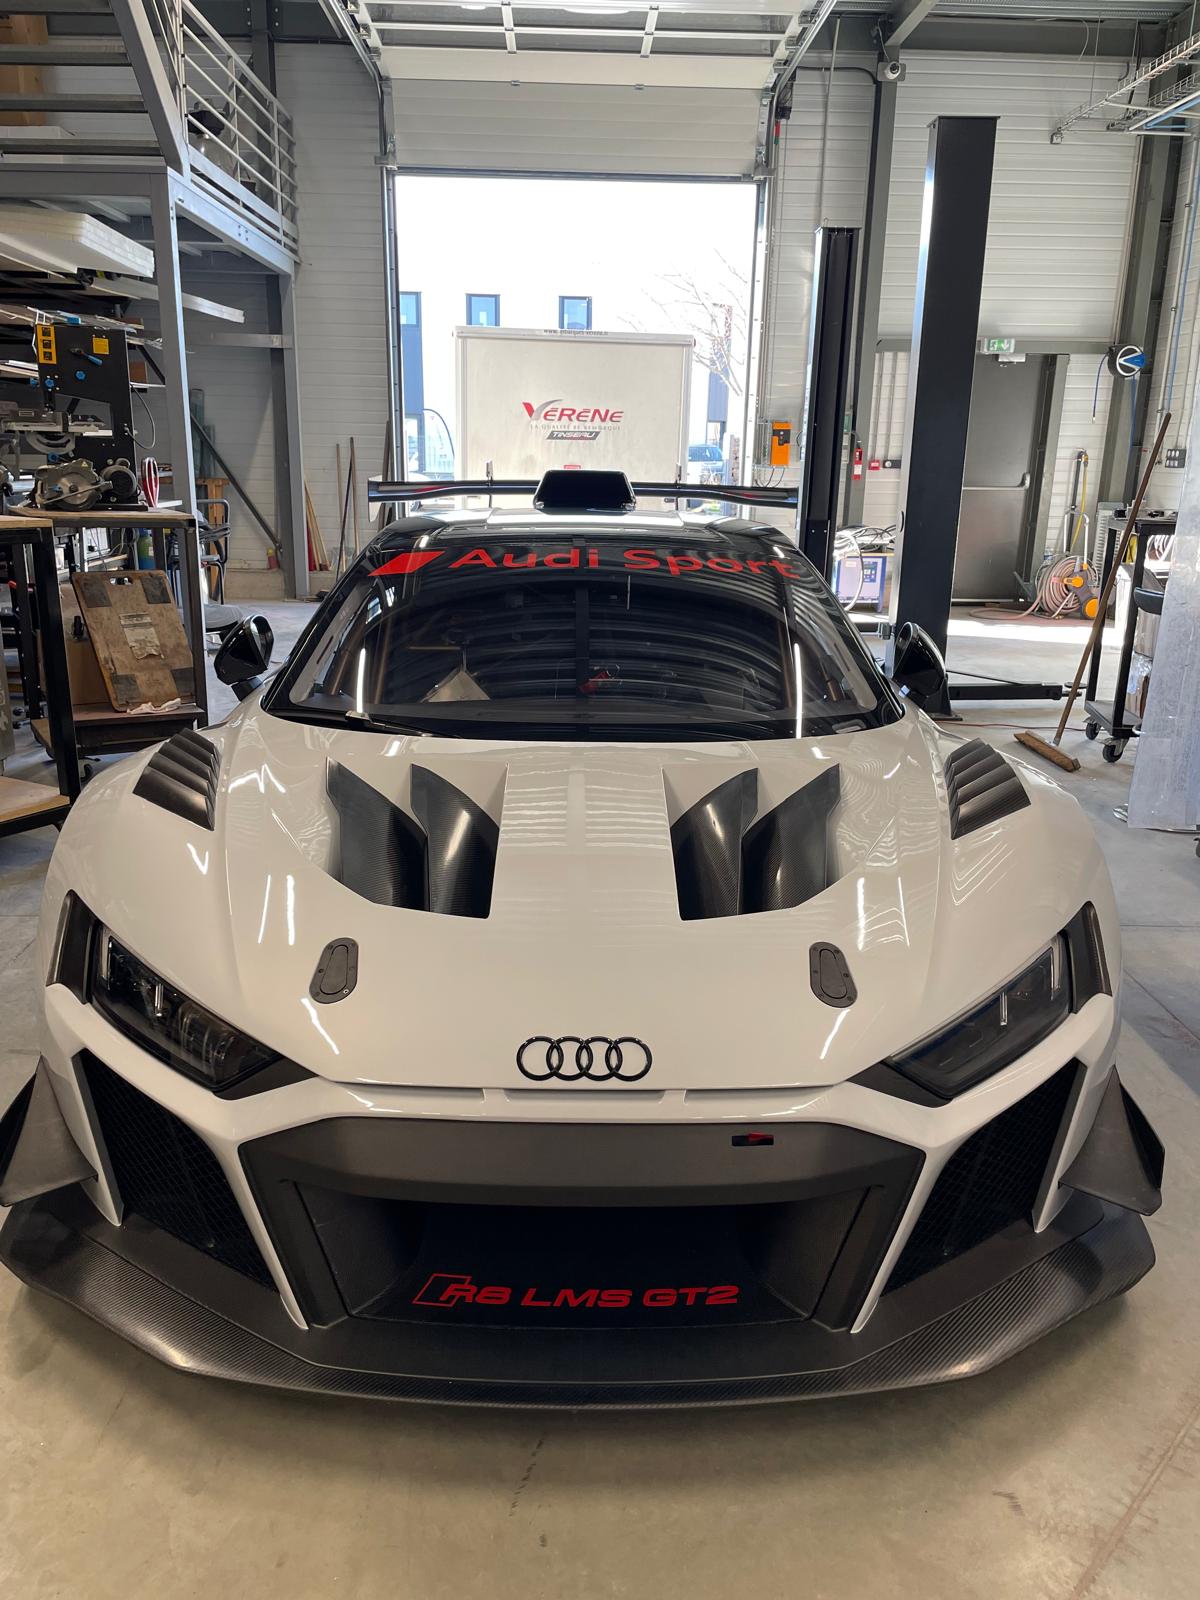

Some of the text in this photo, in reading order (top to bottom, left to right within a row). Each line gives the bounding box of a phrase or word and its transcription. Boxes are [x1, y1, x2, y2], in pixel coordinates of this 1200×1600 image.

[448, 547, 801, 578] Audi Sport
[438, 1282, 739, 1308] R8 LMS GT2
